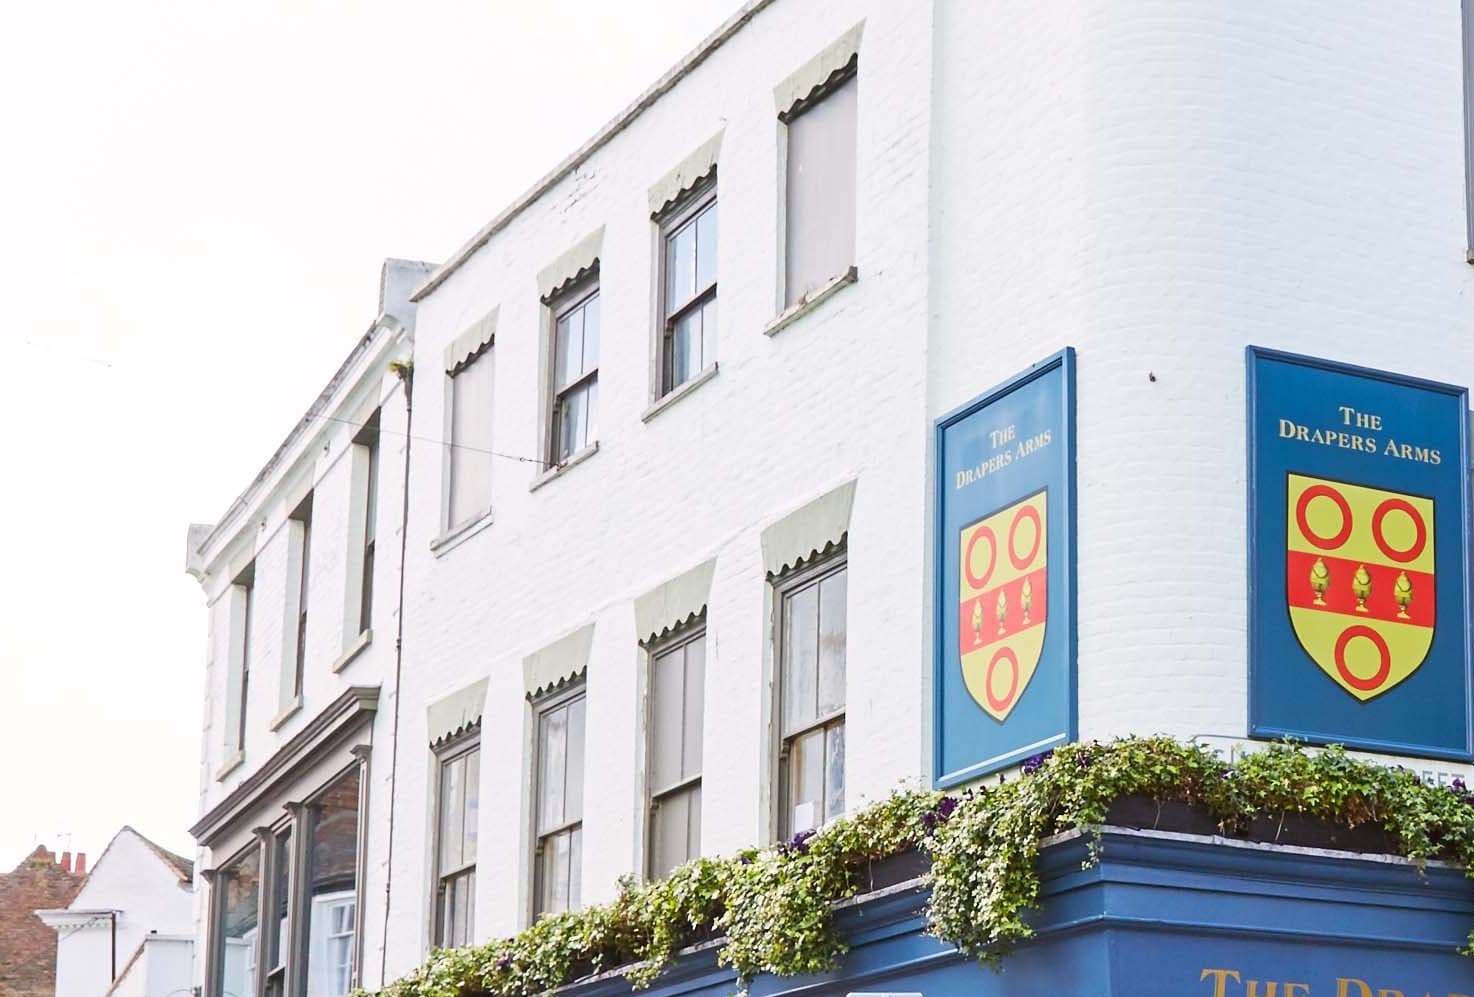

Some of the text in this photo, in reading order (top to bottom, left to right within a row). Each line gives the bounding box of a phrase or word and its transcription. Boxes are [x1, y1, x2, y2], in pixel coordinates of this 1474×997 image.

[989, 424, 1016, 449] THE
[1338, 406, 1383, 431] THE
[956, 429, 1052, 489] DRAPERS ARMS
[1279, 418, 1442, 465] DRAPERS ARMS
